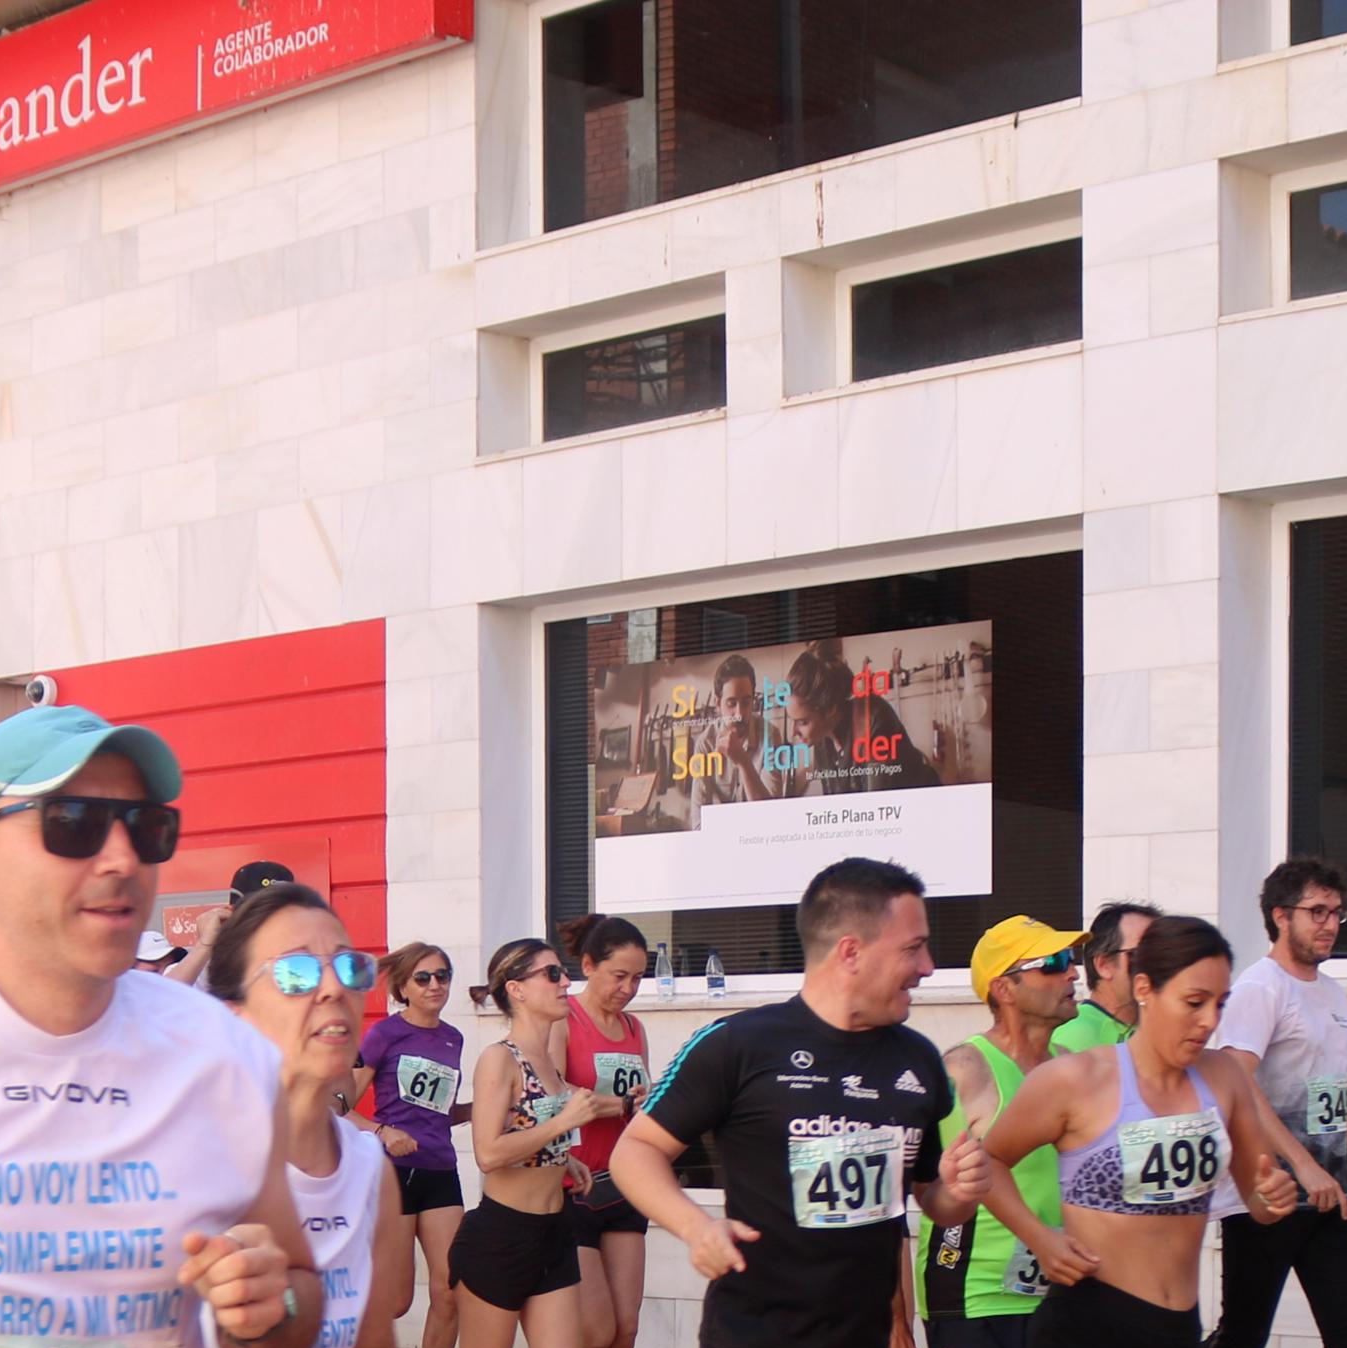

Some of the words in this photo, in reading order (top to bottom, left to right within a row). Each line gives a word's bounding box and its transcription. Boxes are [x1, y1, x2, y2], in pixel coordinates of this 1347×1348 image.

[213, 22, 329, 77] COLABORADOR
[214, 21, 272, 57] AGENTE
[672, 685, 696, 718] Si
[763, 676, 792, 710] te
[852, 664, 891, 698] da
[672, 744, 723, 781] San
[763, 739, 811, 773] tan
[853, 729, 903, 764] der
[806, 811, 838, 826] Tarifa
[842, 808, 875, 824] Plana
[878, 805, 902, 821] TPV
[3, 1083, 131, 1107] GIVOVA
[410, 1071, 441, 1102] 61
[613, 1067, 642, 1097] 60
[29, 1161, 79, 1204] VOY
[808, 1153, 888, 1211] 497
[1140, 1134, 1219, 1191] 498
[60, 1296, 77, 1336] A
[82, 1295, 113, 1337] MI
[115, 1287, 183, 1335] RITMO
